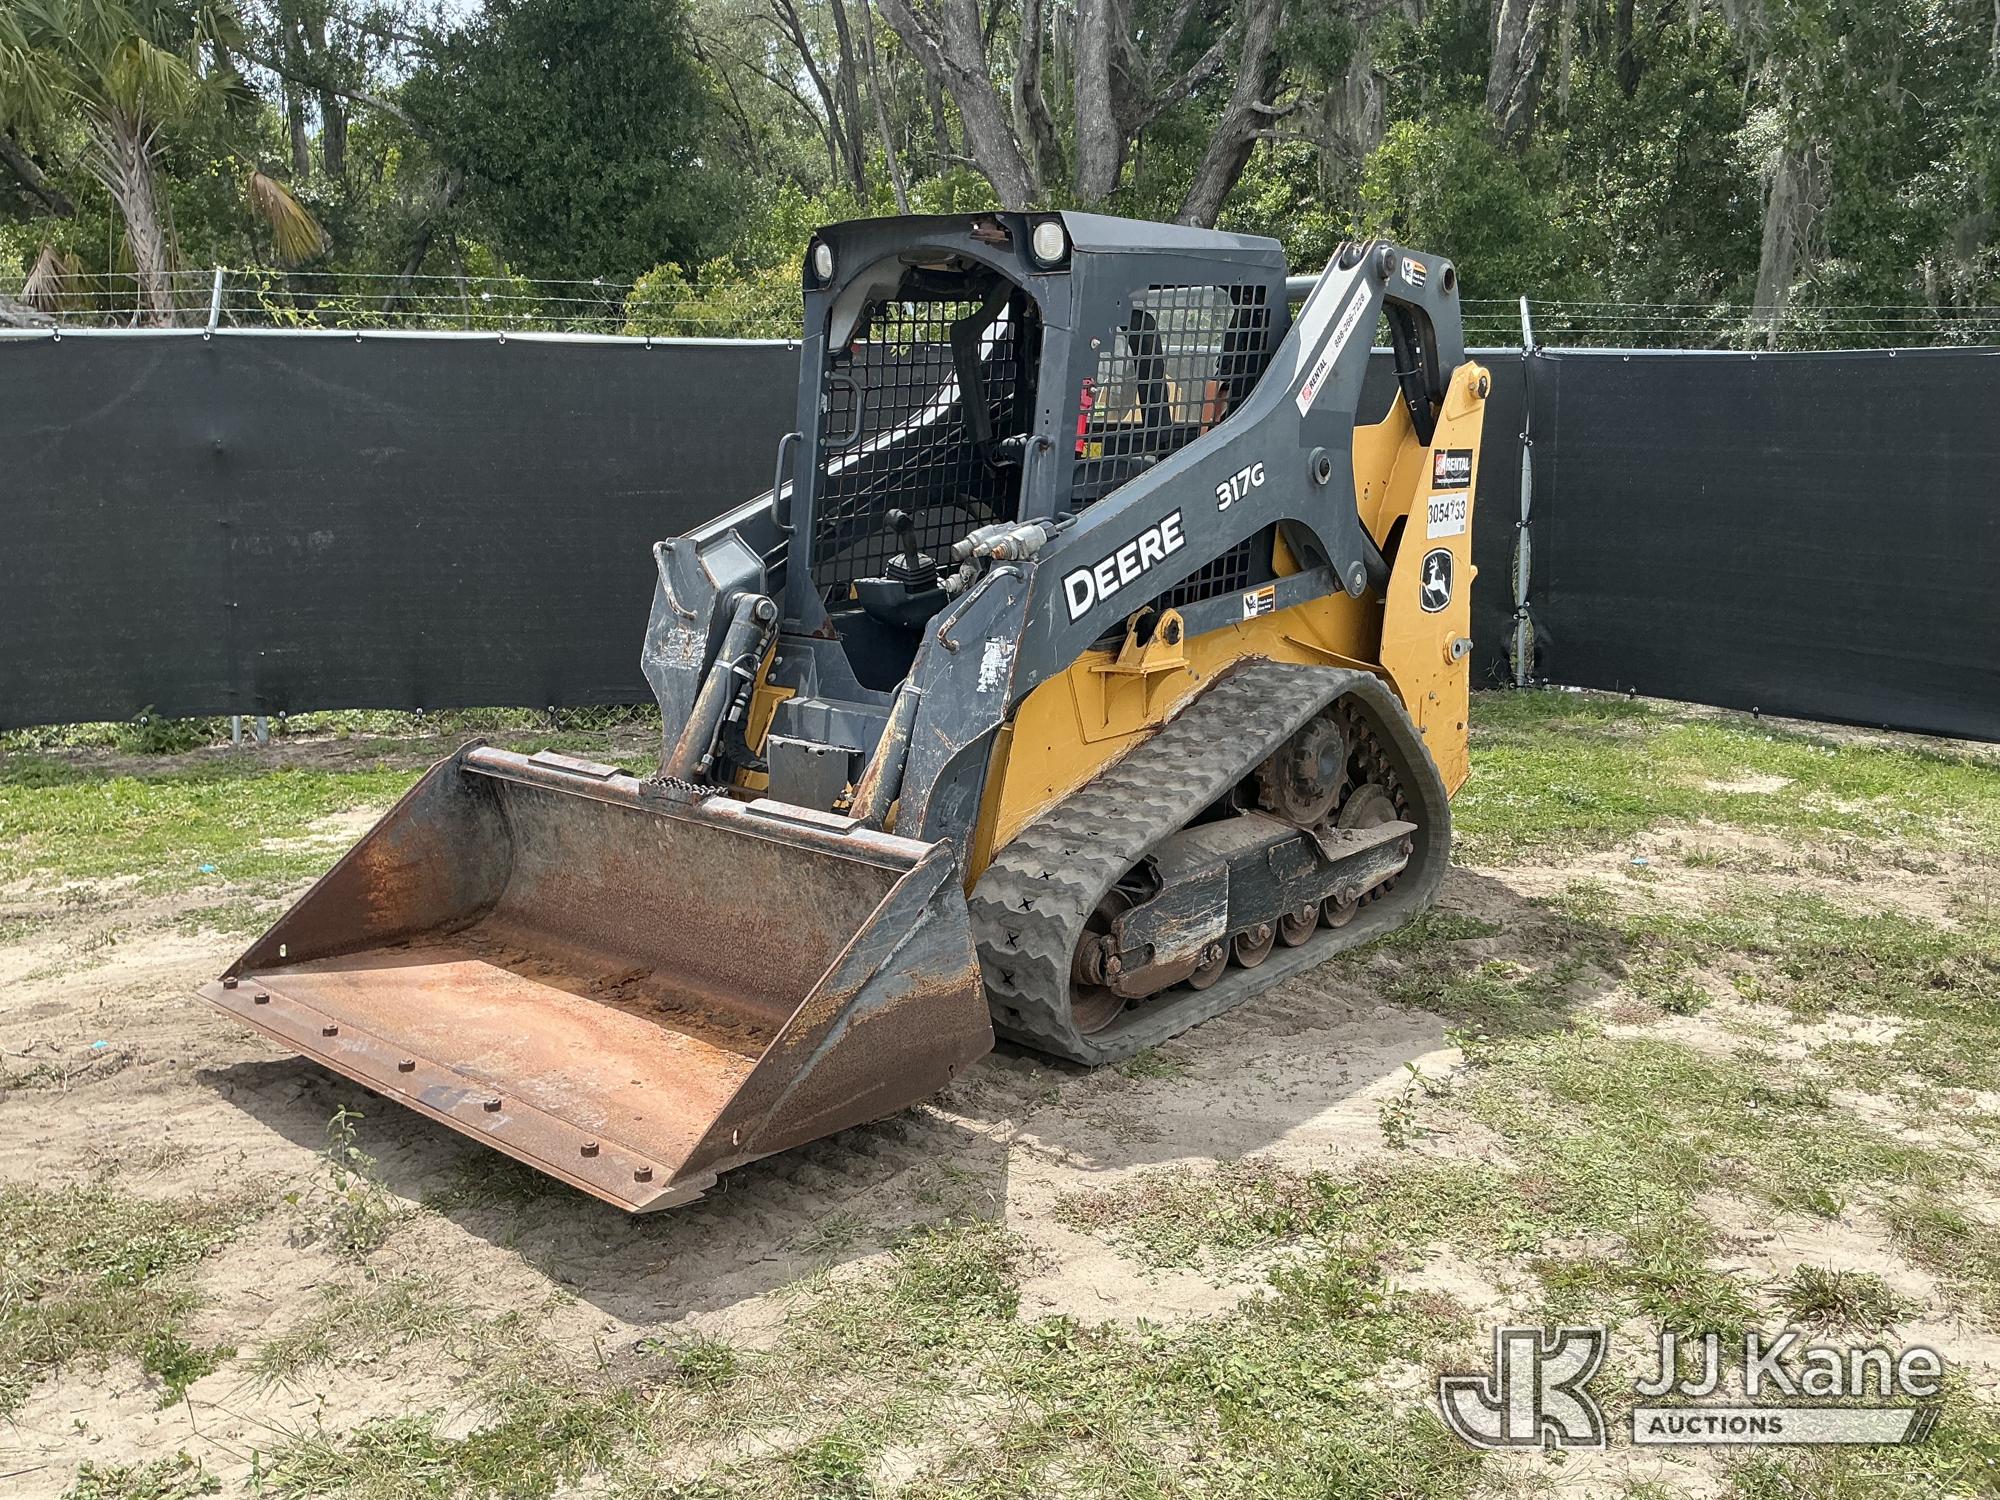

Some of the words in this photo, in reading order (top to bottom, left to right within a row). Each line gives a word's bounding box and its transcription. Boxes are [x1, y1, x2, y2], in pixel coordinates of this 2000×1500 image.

[1308, 359, 1327, 390] RENTAL
[1446, 457, 1470, 472] RENTAL
[1215, 462, 1265, 512] 317G
[1063, 511, 1185, 622] DEERE
